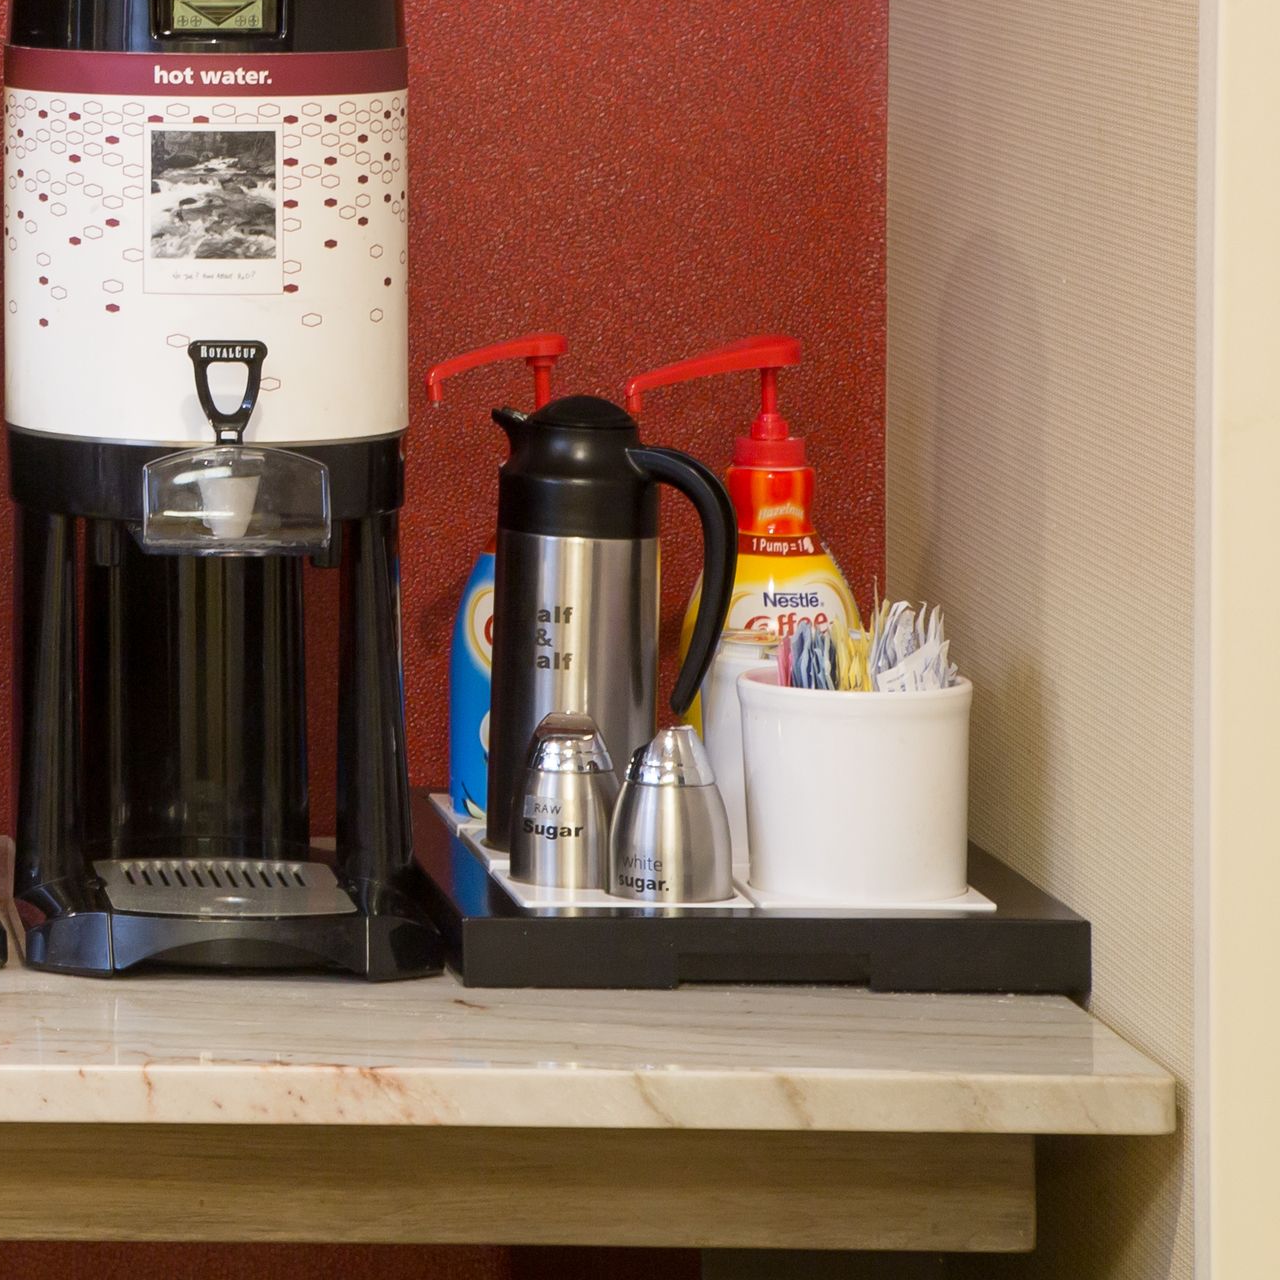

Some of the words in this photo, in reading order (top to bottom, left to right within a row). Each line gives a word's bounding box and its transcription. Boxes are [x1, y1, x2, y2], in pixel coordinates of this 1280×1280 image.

[153, 65, 195, 85] hot
[200, 67, 273, 85] water.
[760, 538, 789, 555] Pump
[537, 606, 573, 625] alf
[536, 628, 553, 648] &
[536, 652, 573, 671] alf
[534, 803, 561, 815] RAW
[523, 820, 584, 840] Sugar
[622, 853, 663, 872] white
[619, 874, 670, 893] sugar.
